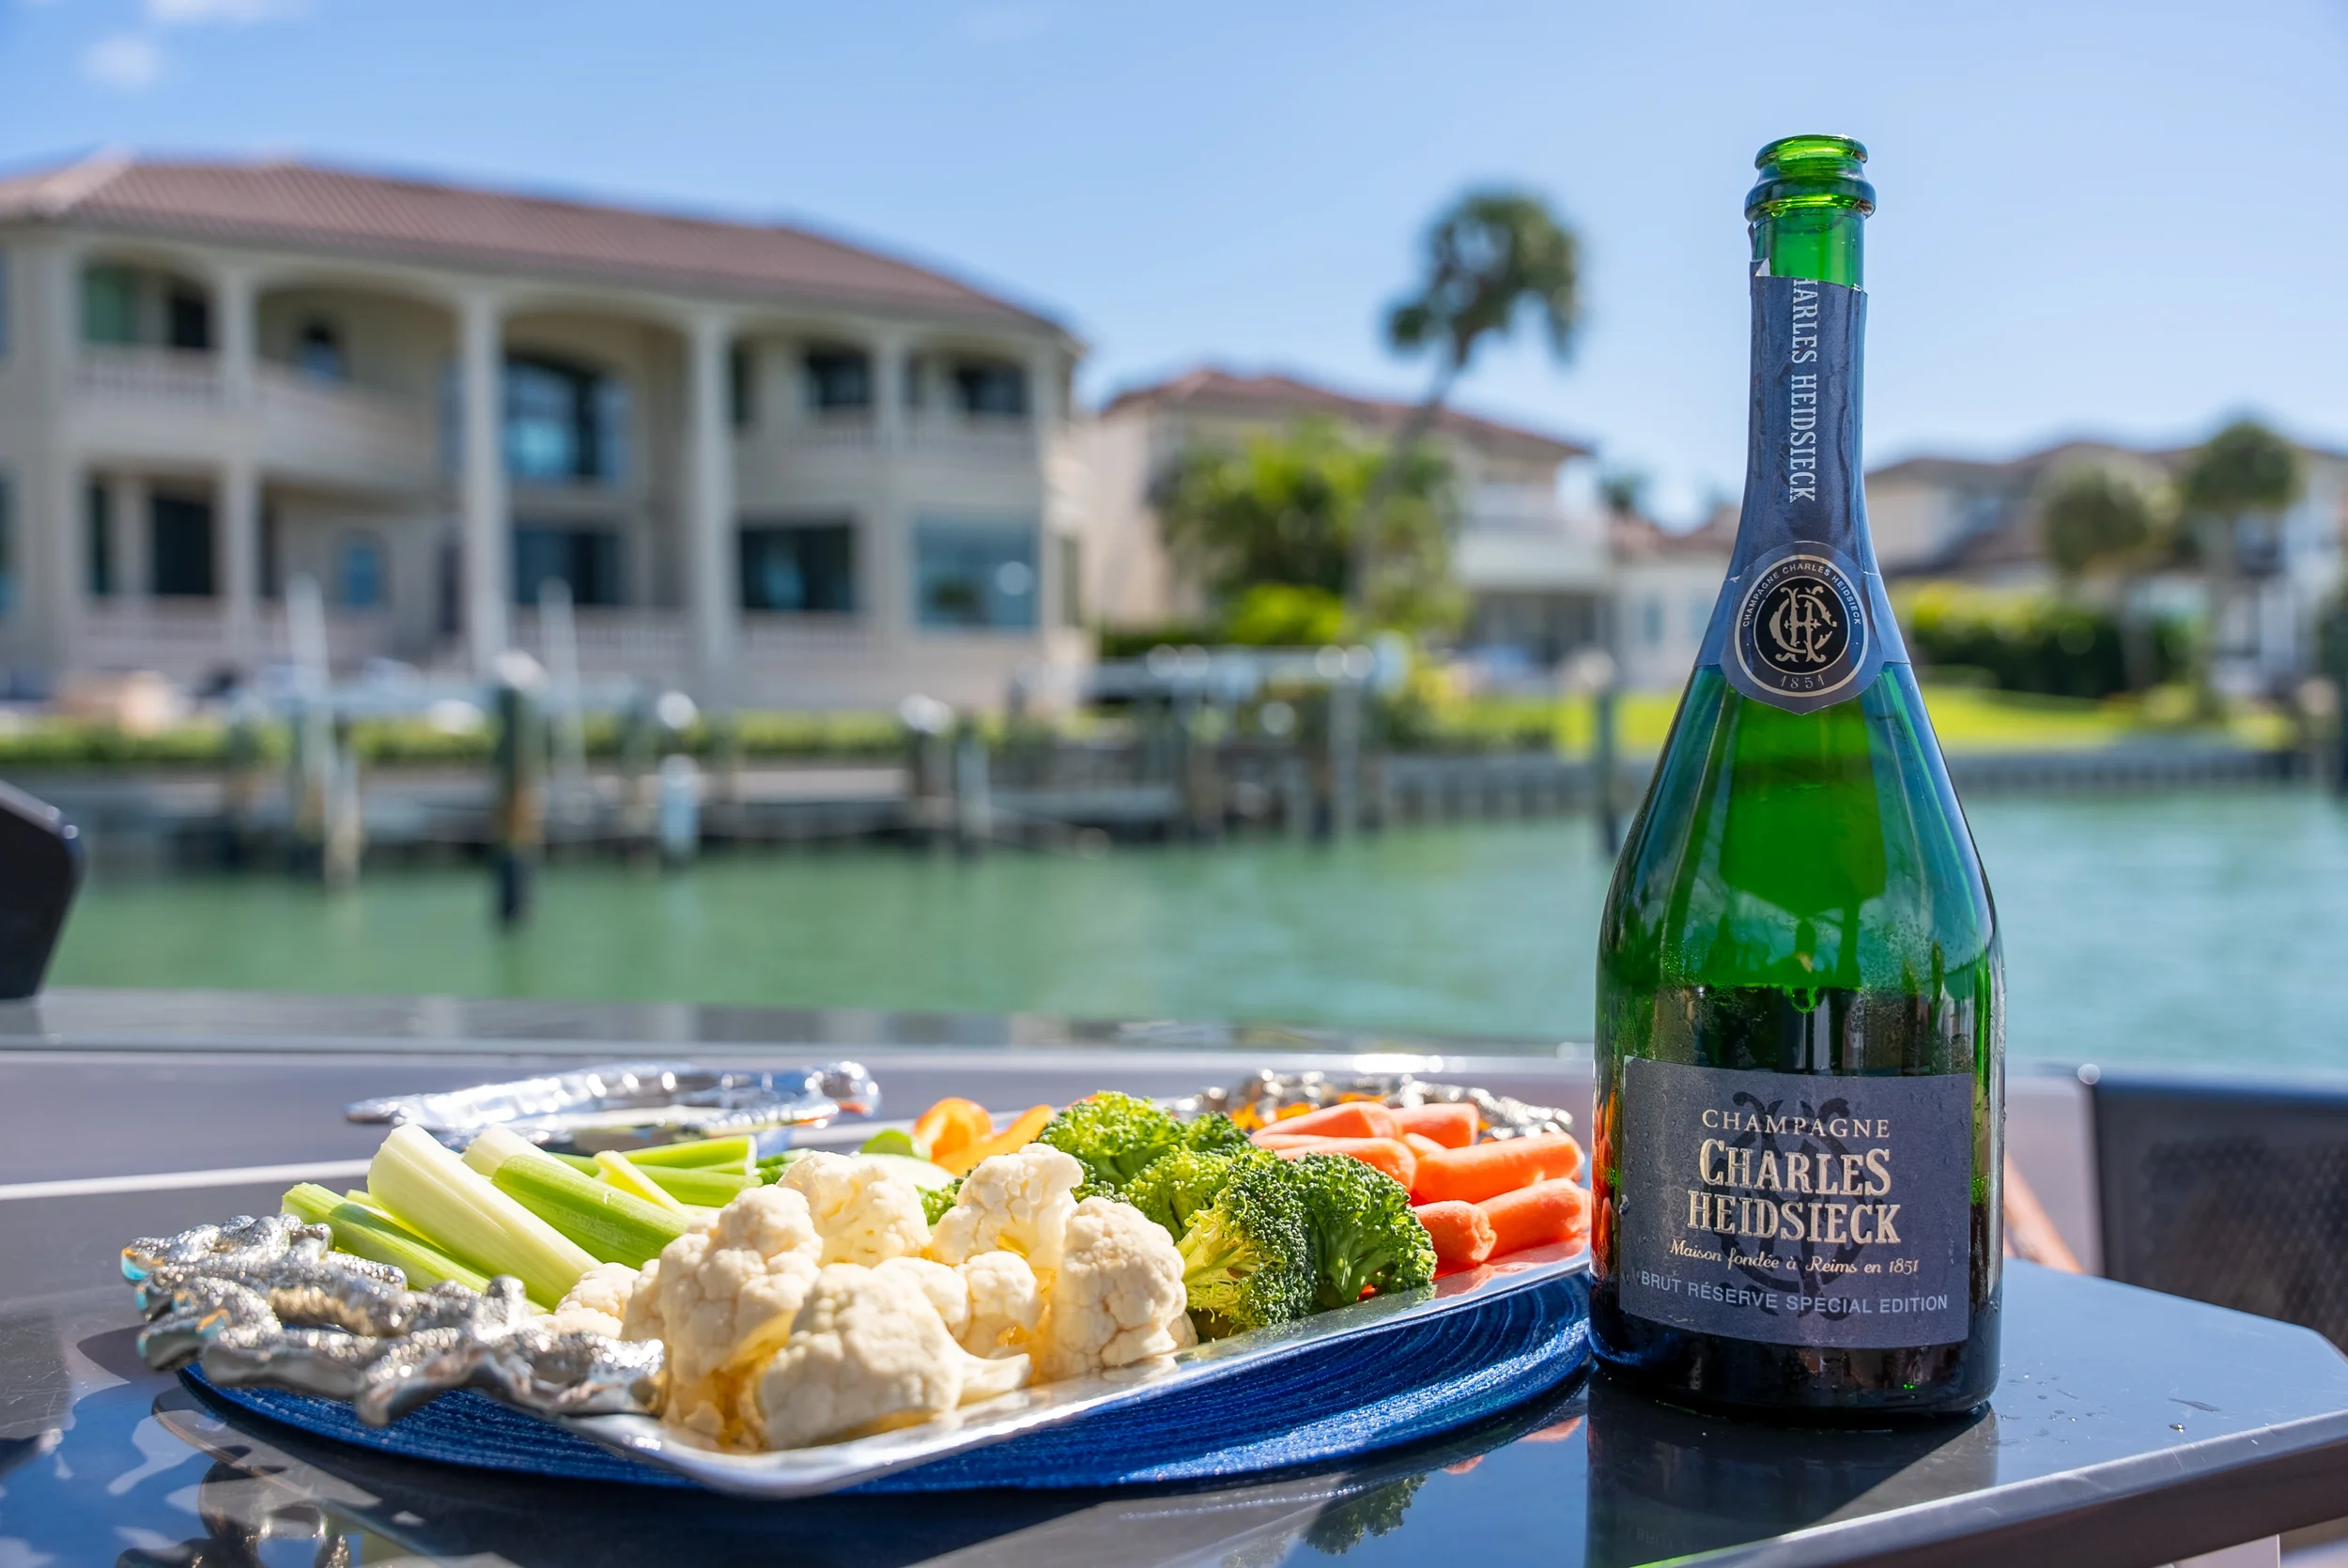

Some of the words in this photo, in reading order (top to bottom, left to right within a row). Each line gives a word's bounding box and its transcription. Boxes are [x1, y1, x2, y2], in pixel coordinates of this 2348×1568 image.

[1789, 373, 1817, 503] HEIDSIECK
[1742, 571, 1780, 627] CHAMPAGNE
[1782, 562, 1831, 577] CHARLES
[1831, 575, 1861, 625] HEIDSIECK
[1780, 673, 1825, 689] 1851
[1701, 1108, 1890, 1139] CHAMPAGNE
[1698, 1138, 1892, 1197] CHARLES
[1687, 1190, 1902, 1244] HEIDSIECK
[1669, 1237, 1722, 1263] Maison
[1727, 1247, 1780, 1270] fondée
[1785, 1255, 1798, 1270] à
[1805, 1255, 1858, 1273] Reims
[1863, 1264, 1882, 1274] en
[1889, 1259, 1920, 1276] 1851
[1641, 1270, 1682, 1294] BRUT
[1688, 1281, 1778, 1309] RÉSERVE
[1785, 1295, 1873, 1314] SPECIAL
[1879, 1294, 1948, 1314] EDITION
